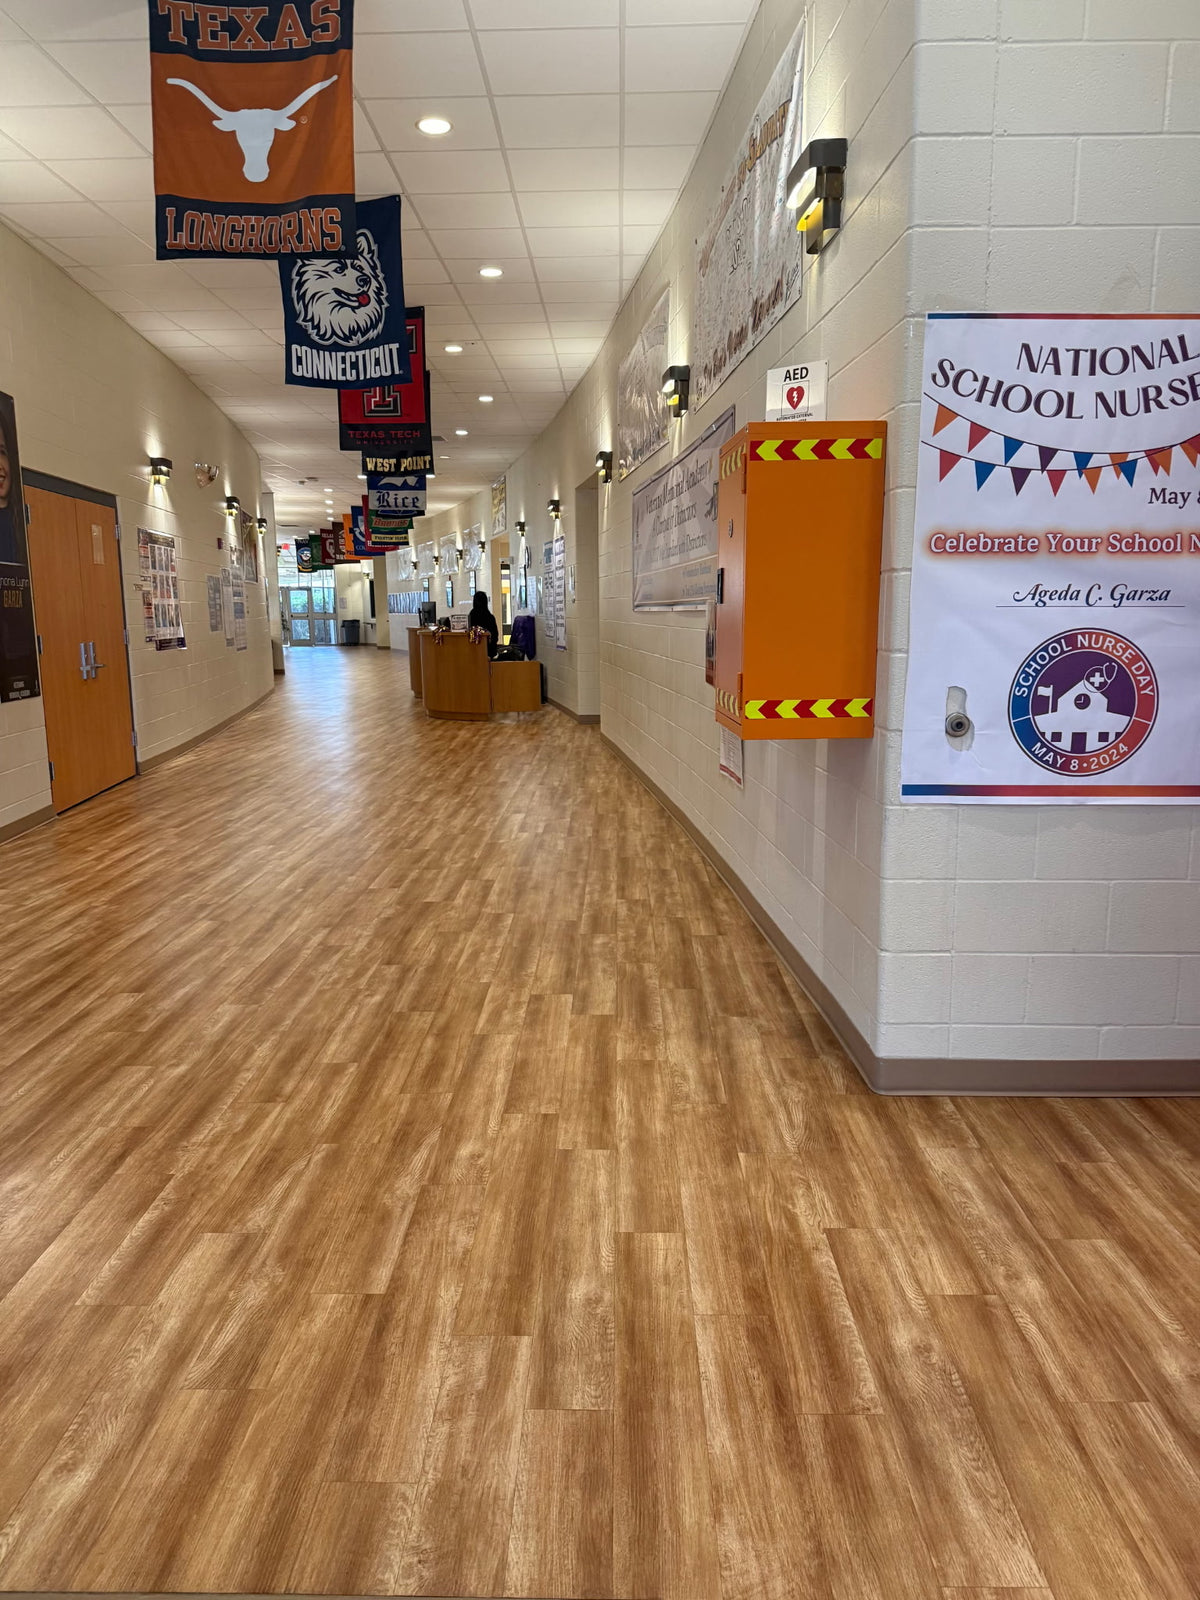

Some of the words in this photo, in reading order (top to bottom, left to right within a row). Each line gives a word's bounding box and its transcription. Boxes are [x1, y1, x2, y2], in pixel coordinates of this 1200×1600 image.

[157, 0, 341, 51] TEXAS
[165, 207, 343, 254] LONGHORNS
[291, 342, 400, 381] CONNECTICUT
[1016, 333, 1200, 376] NATIONAL
[783, 366, 809, 382] AED
[931, 358, 1084, 419] SCHOOL
[348, 430, 385, 439] TEXAS
[389, 430, 421, 438] TECH
[366, 457, 397, 472] WEST
[400, 455, 431, 472] POINT
[376, 490, 420, 509] Rice
[1148, 487, 1192, 510] May
[930, 532, 1040, 554] Celebrate
[1047, 532, 1102, 554] Your
[1107, 532, 1182, 553] School
[1013, 583, 1082, 608] Ageda
[1085, 583, 1103, 607] C.
[1110, 583, 1171, 608] Garza
[1015, 638, 1073, 698] SCHOOL
[1077, 633, 1136, 663] NURSE
[1131, 661, 1155, 697] DAY
[1031, 742, 1067, 768] MAY
[1069, 759, 1079, 771] 8
[1089, 742, 1129, 770] 2024
